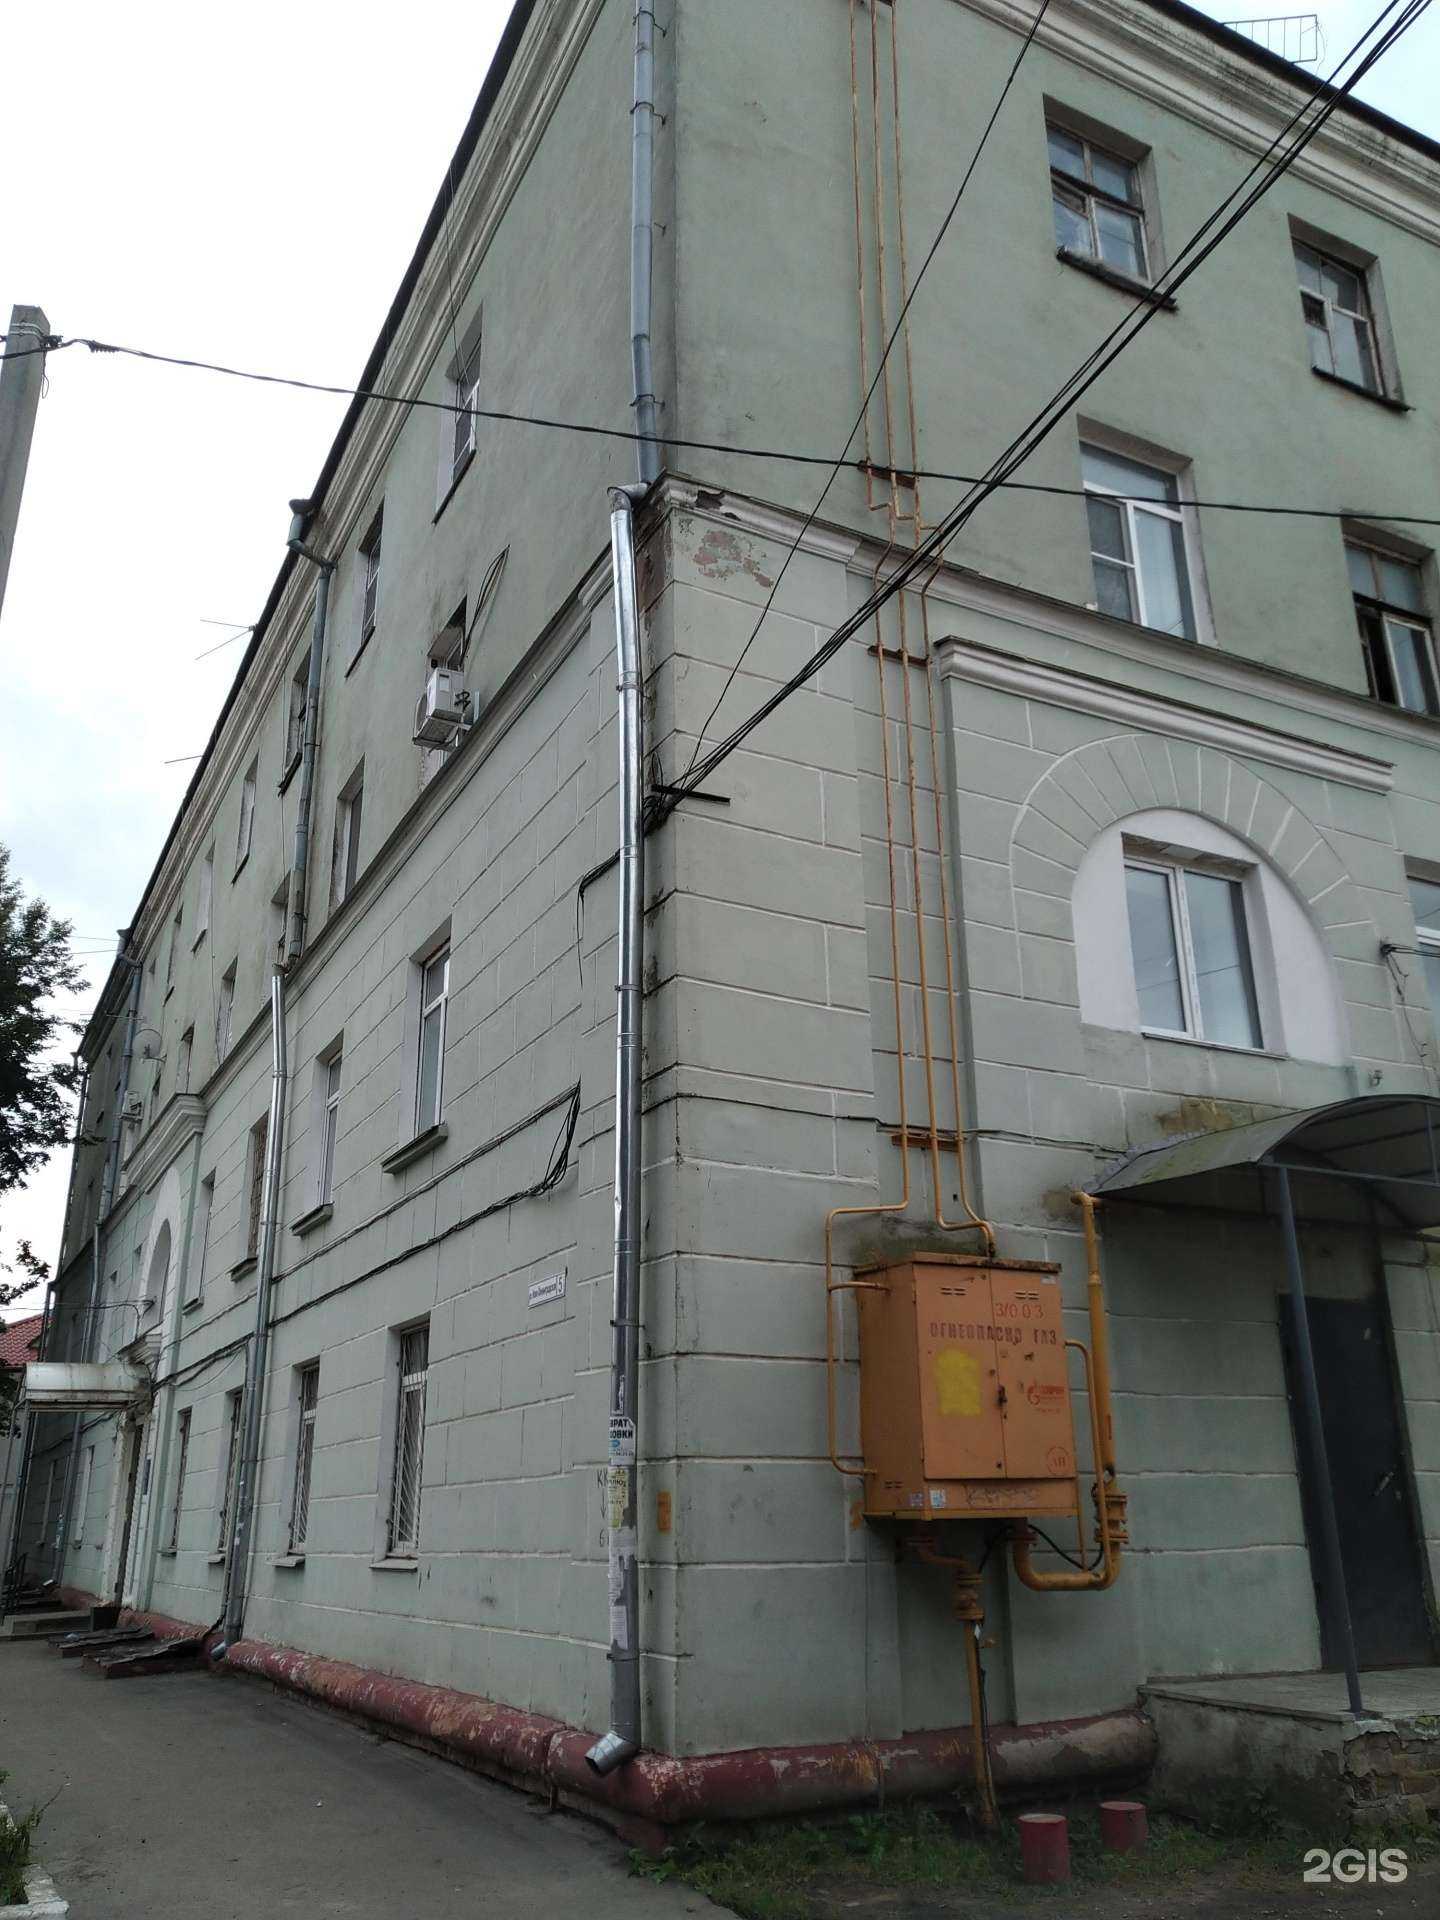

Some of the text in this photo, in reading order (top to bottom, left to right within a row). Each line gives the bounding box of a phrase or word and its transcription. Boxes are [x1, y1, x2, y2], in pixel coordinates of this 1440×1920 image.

[558, 1277, 563, 1293] 5
[929, 1322, 1057, 1345] ОГНЕОПАСНО ГАЗ
